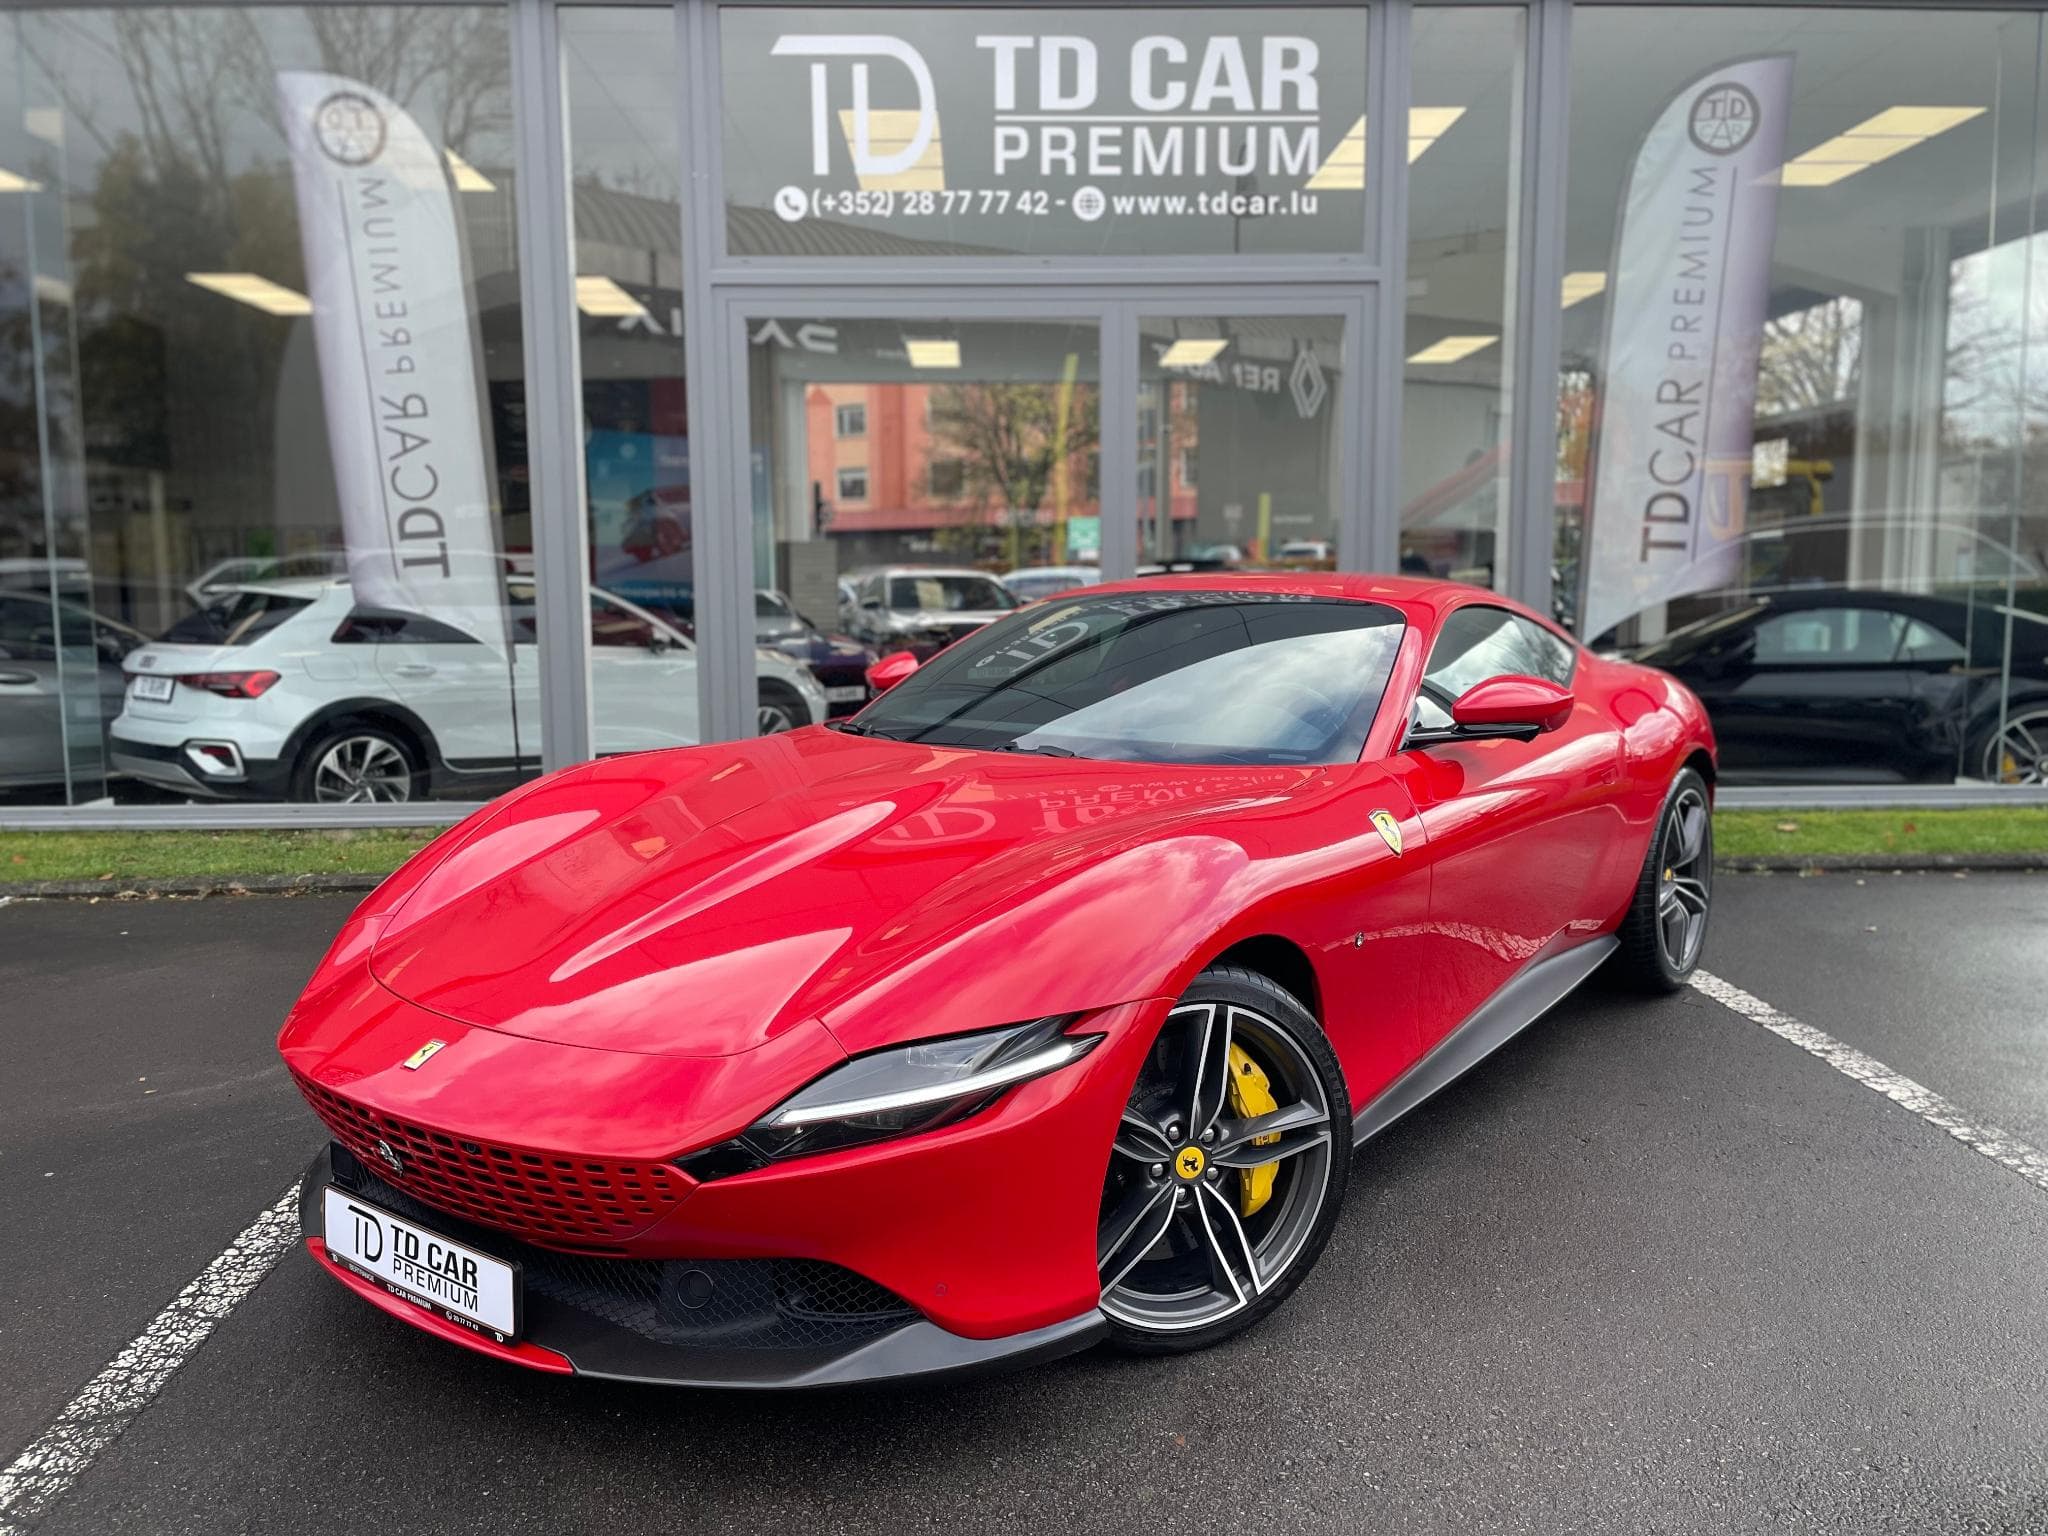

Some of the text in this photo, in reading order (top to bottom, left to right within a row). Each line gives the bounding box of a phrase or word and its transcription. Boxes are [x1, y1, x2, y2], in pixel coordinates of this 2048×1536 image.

[975, 35, 1320, 112] TD CAR
[770, 34, 937, 176] TD
[1705, 97, 1746, 119] TD
[994, 126, 1320, 176] PREMIUM
[811, 187, 895, 218] (+352)
[902, 190, 936, 216] 28
[941, 190, 972, 215] 77
[978, 190, 1011, 215] 77
[1015, 190, 1049, 216] 42
[1112, 190, 1319, 215] www.tdcar.lu
[1640, 166, 1718, 564] TDCAR PREMIUM
[347, 1204, 384, 1263] TD
[390, 1224, 478, 1288] TD CAR
[393, 1259, 479, 1312] PREMIUM
